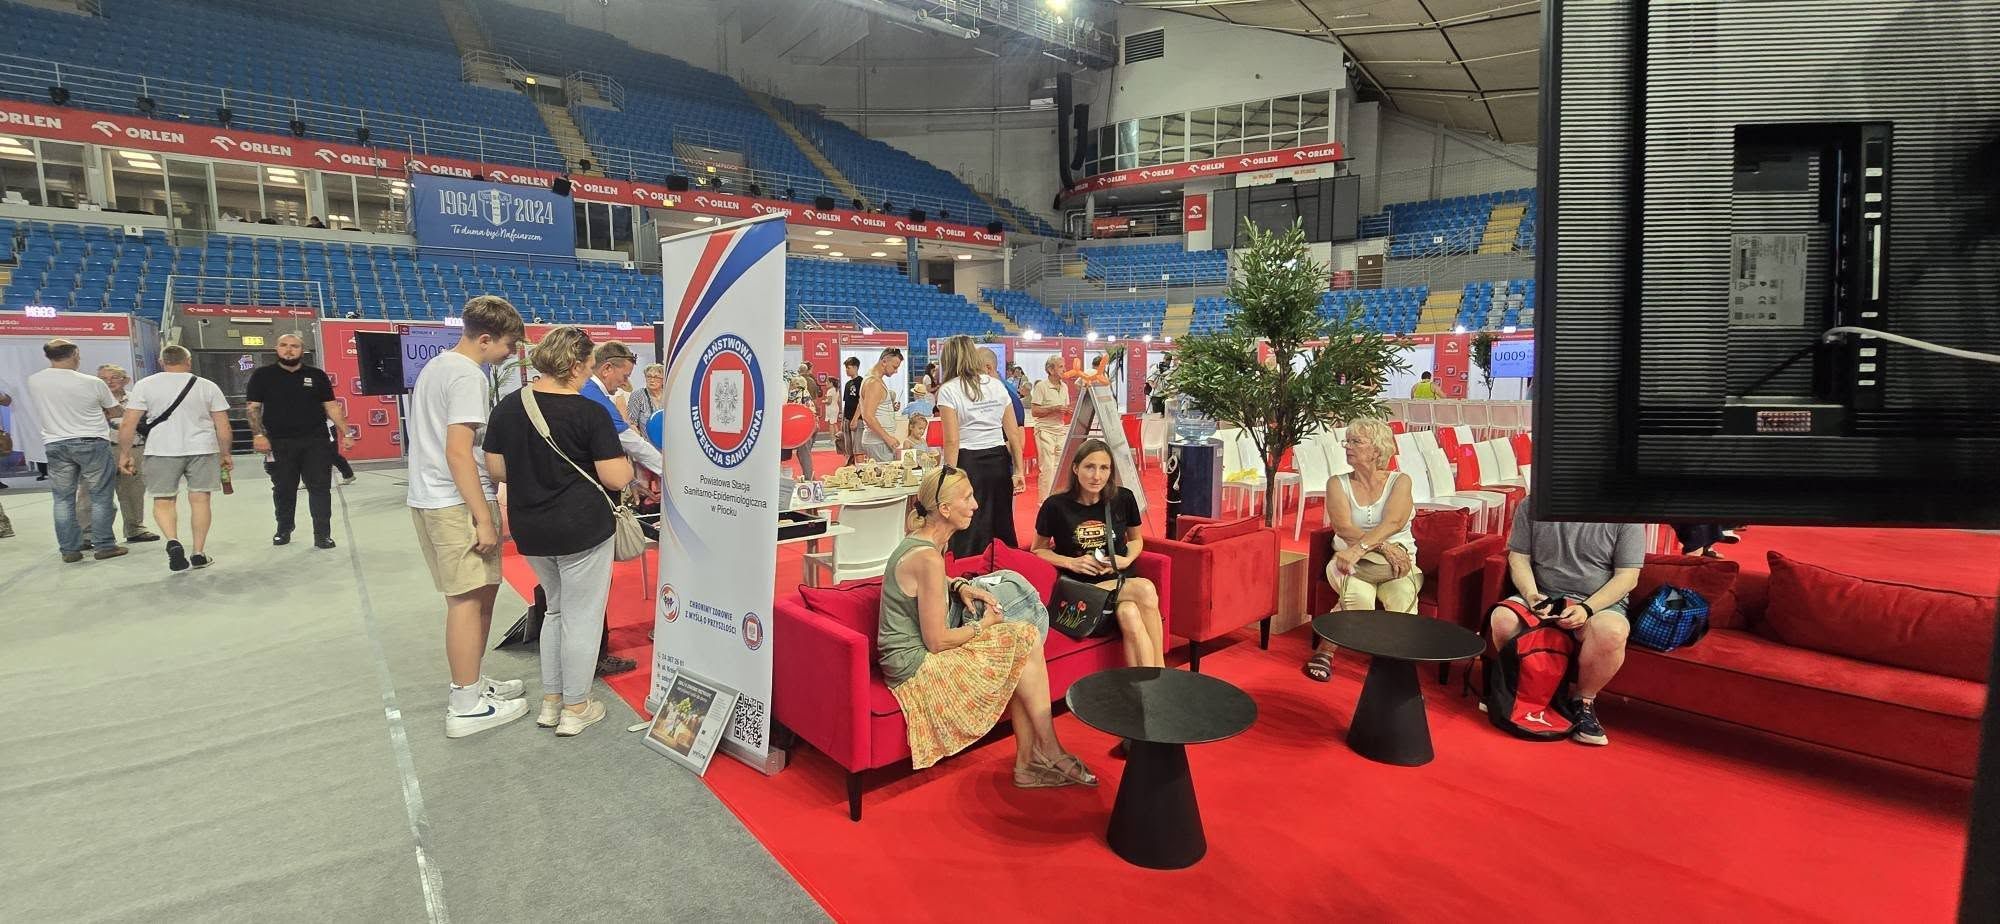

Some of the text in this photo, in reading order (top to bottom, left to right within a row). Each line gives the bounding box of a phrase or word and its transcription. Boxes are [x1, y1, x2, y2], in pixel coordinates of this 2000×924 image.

[125, 126, 185, 144] ORLEN
[239, 141, 292, 157] ORLEN
[1308, 148, 1335, 158] ORLEN
[340, 153, 388, 168] ORLEN
[1252, 156, 1279, 165] ORLEN
[430, 163, 473, 178] ORLEN
[1151, 168, 1175, 177] ORLEN
[1200, 162, 1225, 172] ORLEN
[511, 174, 549, 187] ORLEN
[584, 183, 618, 195] ORLEN
[650, 191, 682, 203] ORLEN
[438, 189, 478, 218] 1964
[513, 197, 554, 225] 2024
[710, 198, 740, 210] ORLEN
[816, 211, 841, 222] ORLEN
[863, 217, 886, 228] ORLEN
[461, 226, 486, 237] duma
[905, 223, 927, 233] ORLEN
[946, 228, 966, 238] ORLEN
[983, 232, 1002, 242] ORLEN
[102, 322, 116, 331] 22
[703, 338, 753, 366] PAŃSTWOWA
[1494, 350, 1526, 362] U009
[691, 406, 763, 466] INSPEKCJA SANITARNA
[700, 474, 751, 492] Powiatowa Stacja
[683, 485, 767, 509] Sanitarno-Epidemiologiczna
[689, 600, 733, 621] CHRONIMY ZDROWIE
[707, 617, 736, 635] PRZYSZŁOŚCI
